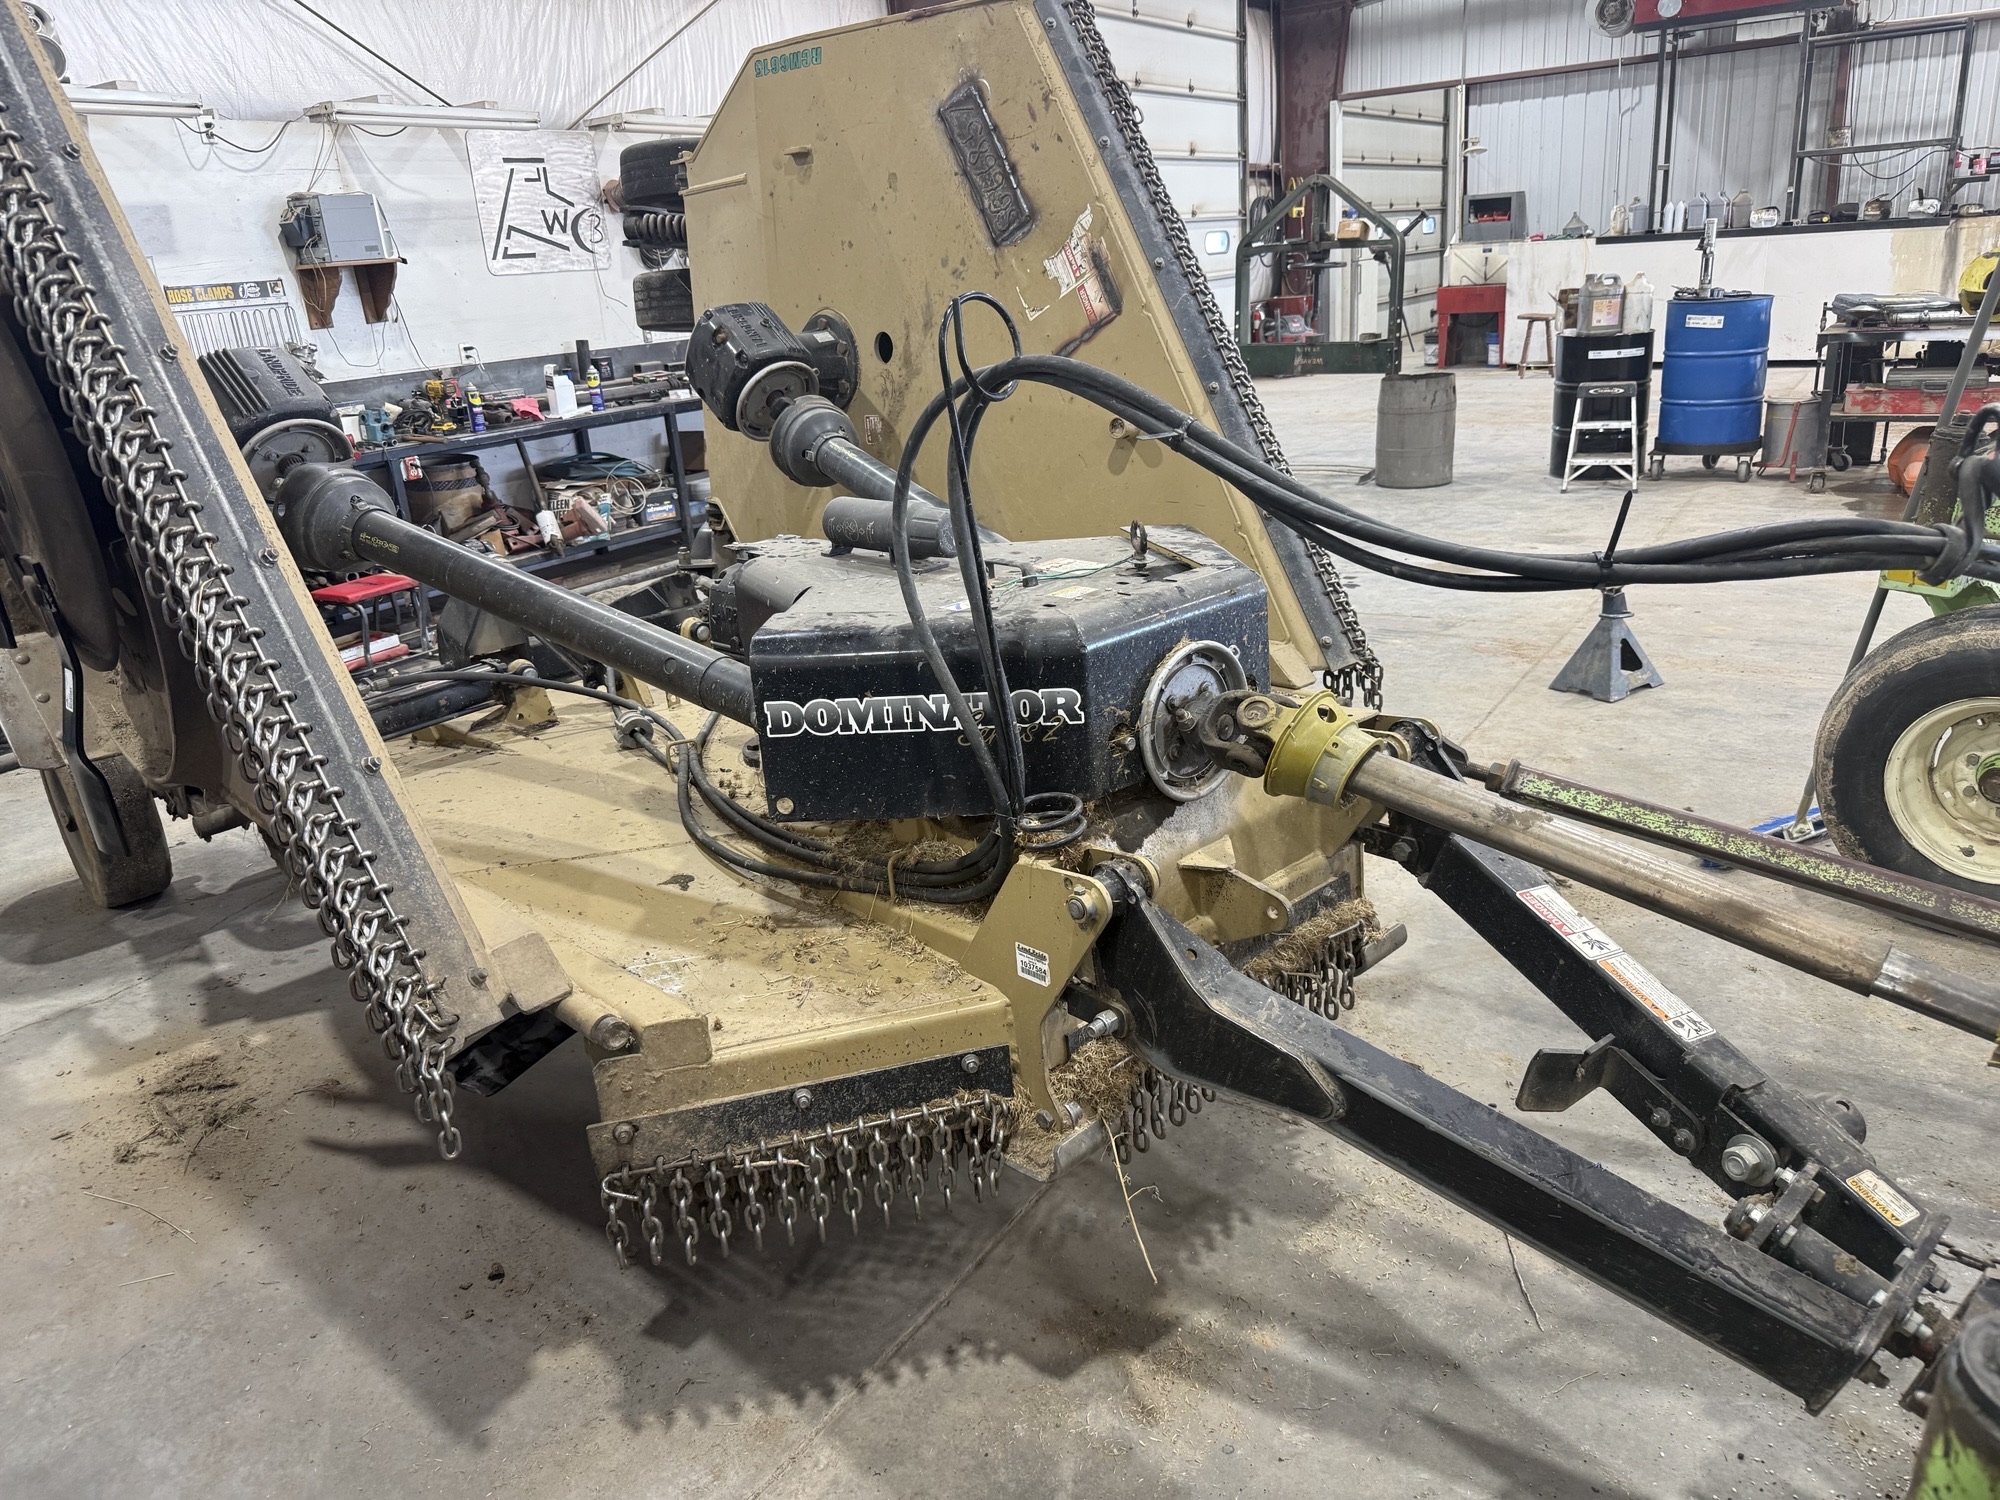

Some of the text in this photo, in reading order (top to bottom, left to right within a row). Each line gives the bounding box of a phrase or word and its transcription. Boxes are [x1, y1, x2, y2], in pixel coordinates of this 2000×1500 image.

[754, 46, 823, 78] RCM6615
[166, 285, 235, 304] HOSE CLAMPS
[1080, 288, 1094, 315] DANGER
[957, 709, 1039, 746] Sers
[1522, 892, 1560, 926] DANGER
[1610, 969, 1648, 1002] WARNING
[1850, 1179, 1889, 1215] WARNING
